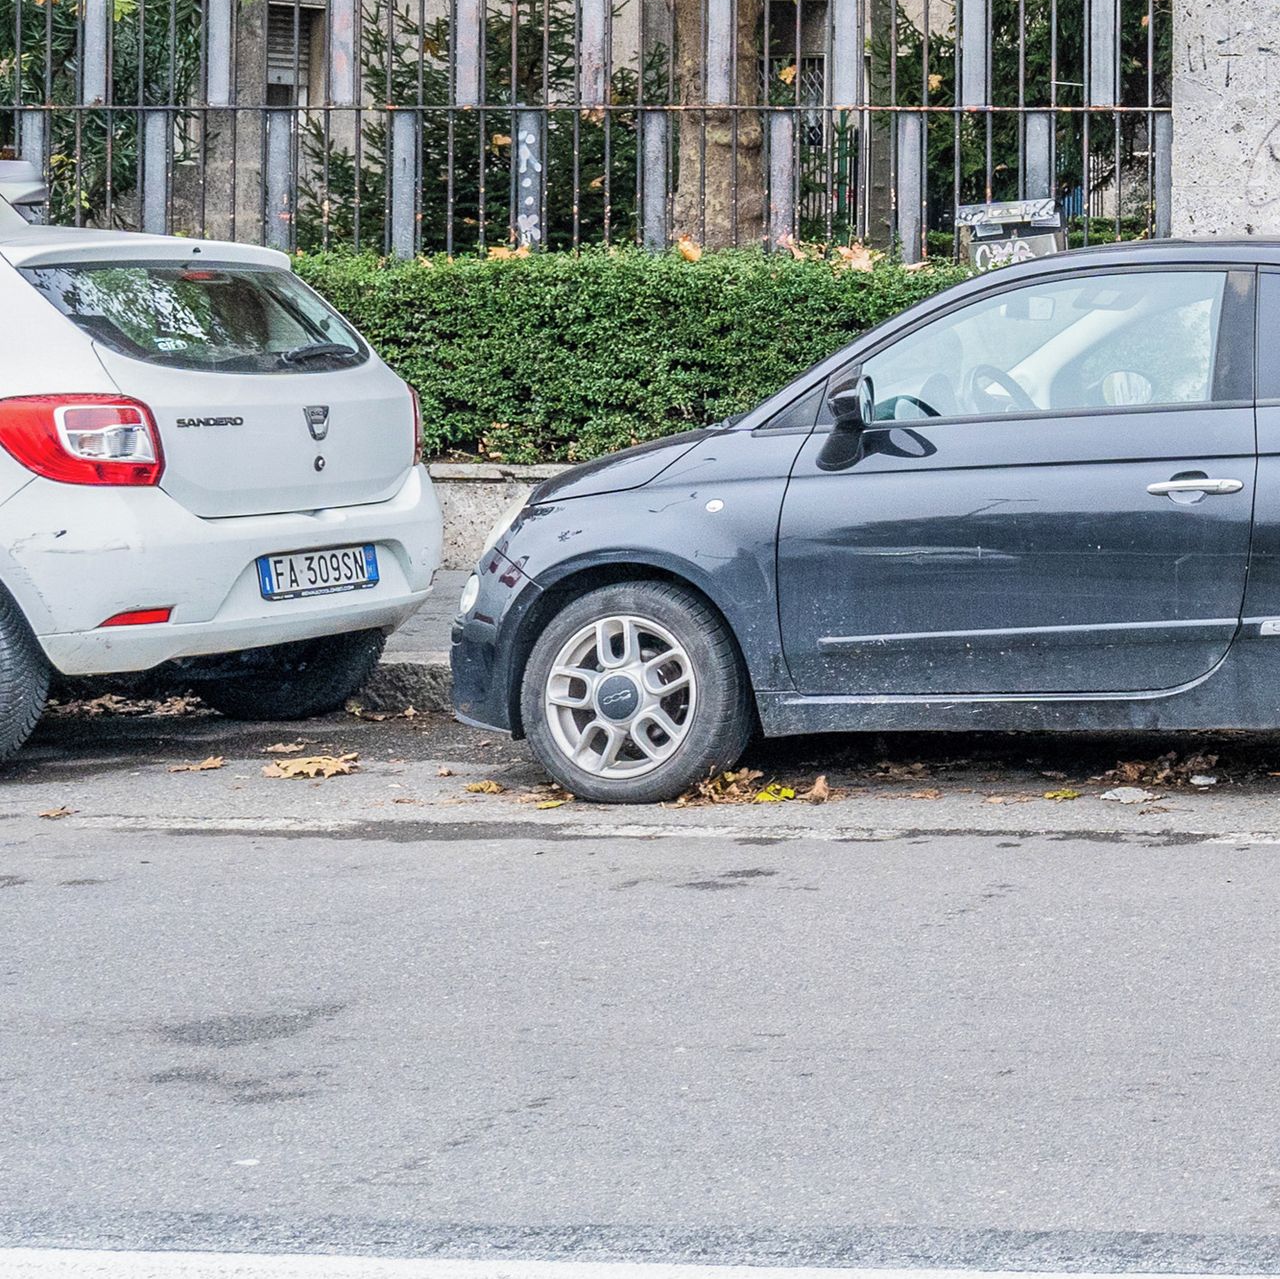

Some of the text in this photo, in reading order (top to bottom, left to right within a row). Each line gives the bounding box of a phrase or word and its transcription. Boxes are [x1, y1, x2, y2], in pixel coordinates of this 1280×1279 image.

[176, 417, 244, 428] SANDERO
[273, 558, 300, 589] FA
[304, 551, 366, 585] 309SN
